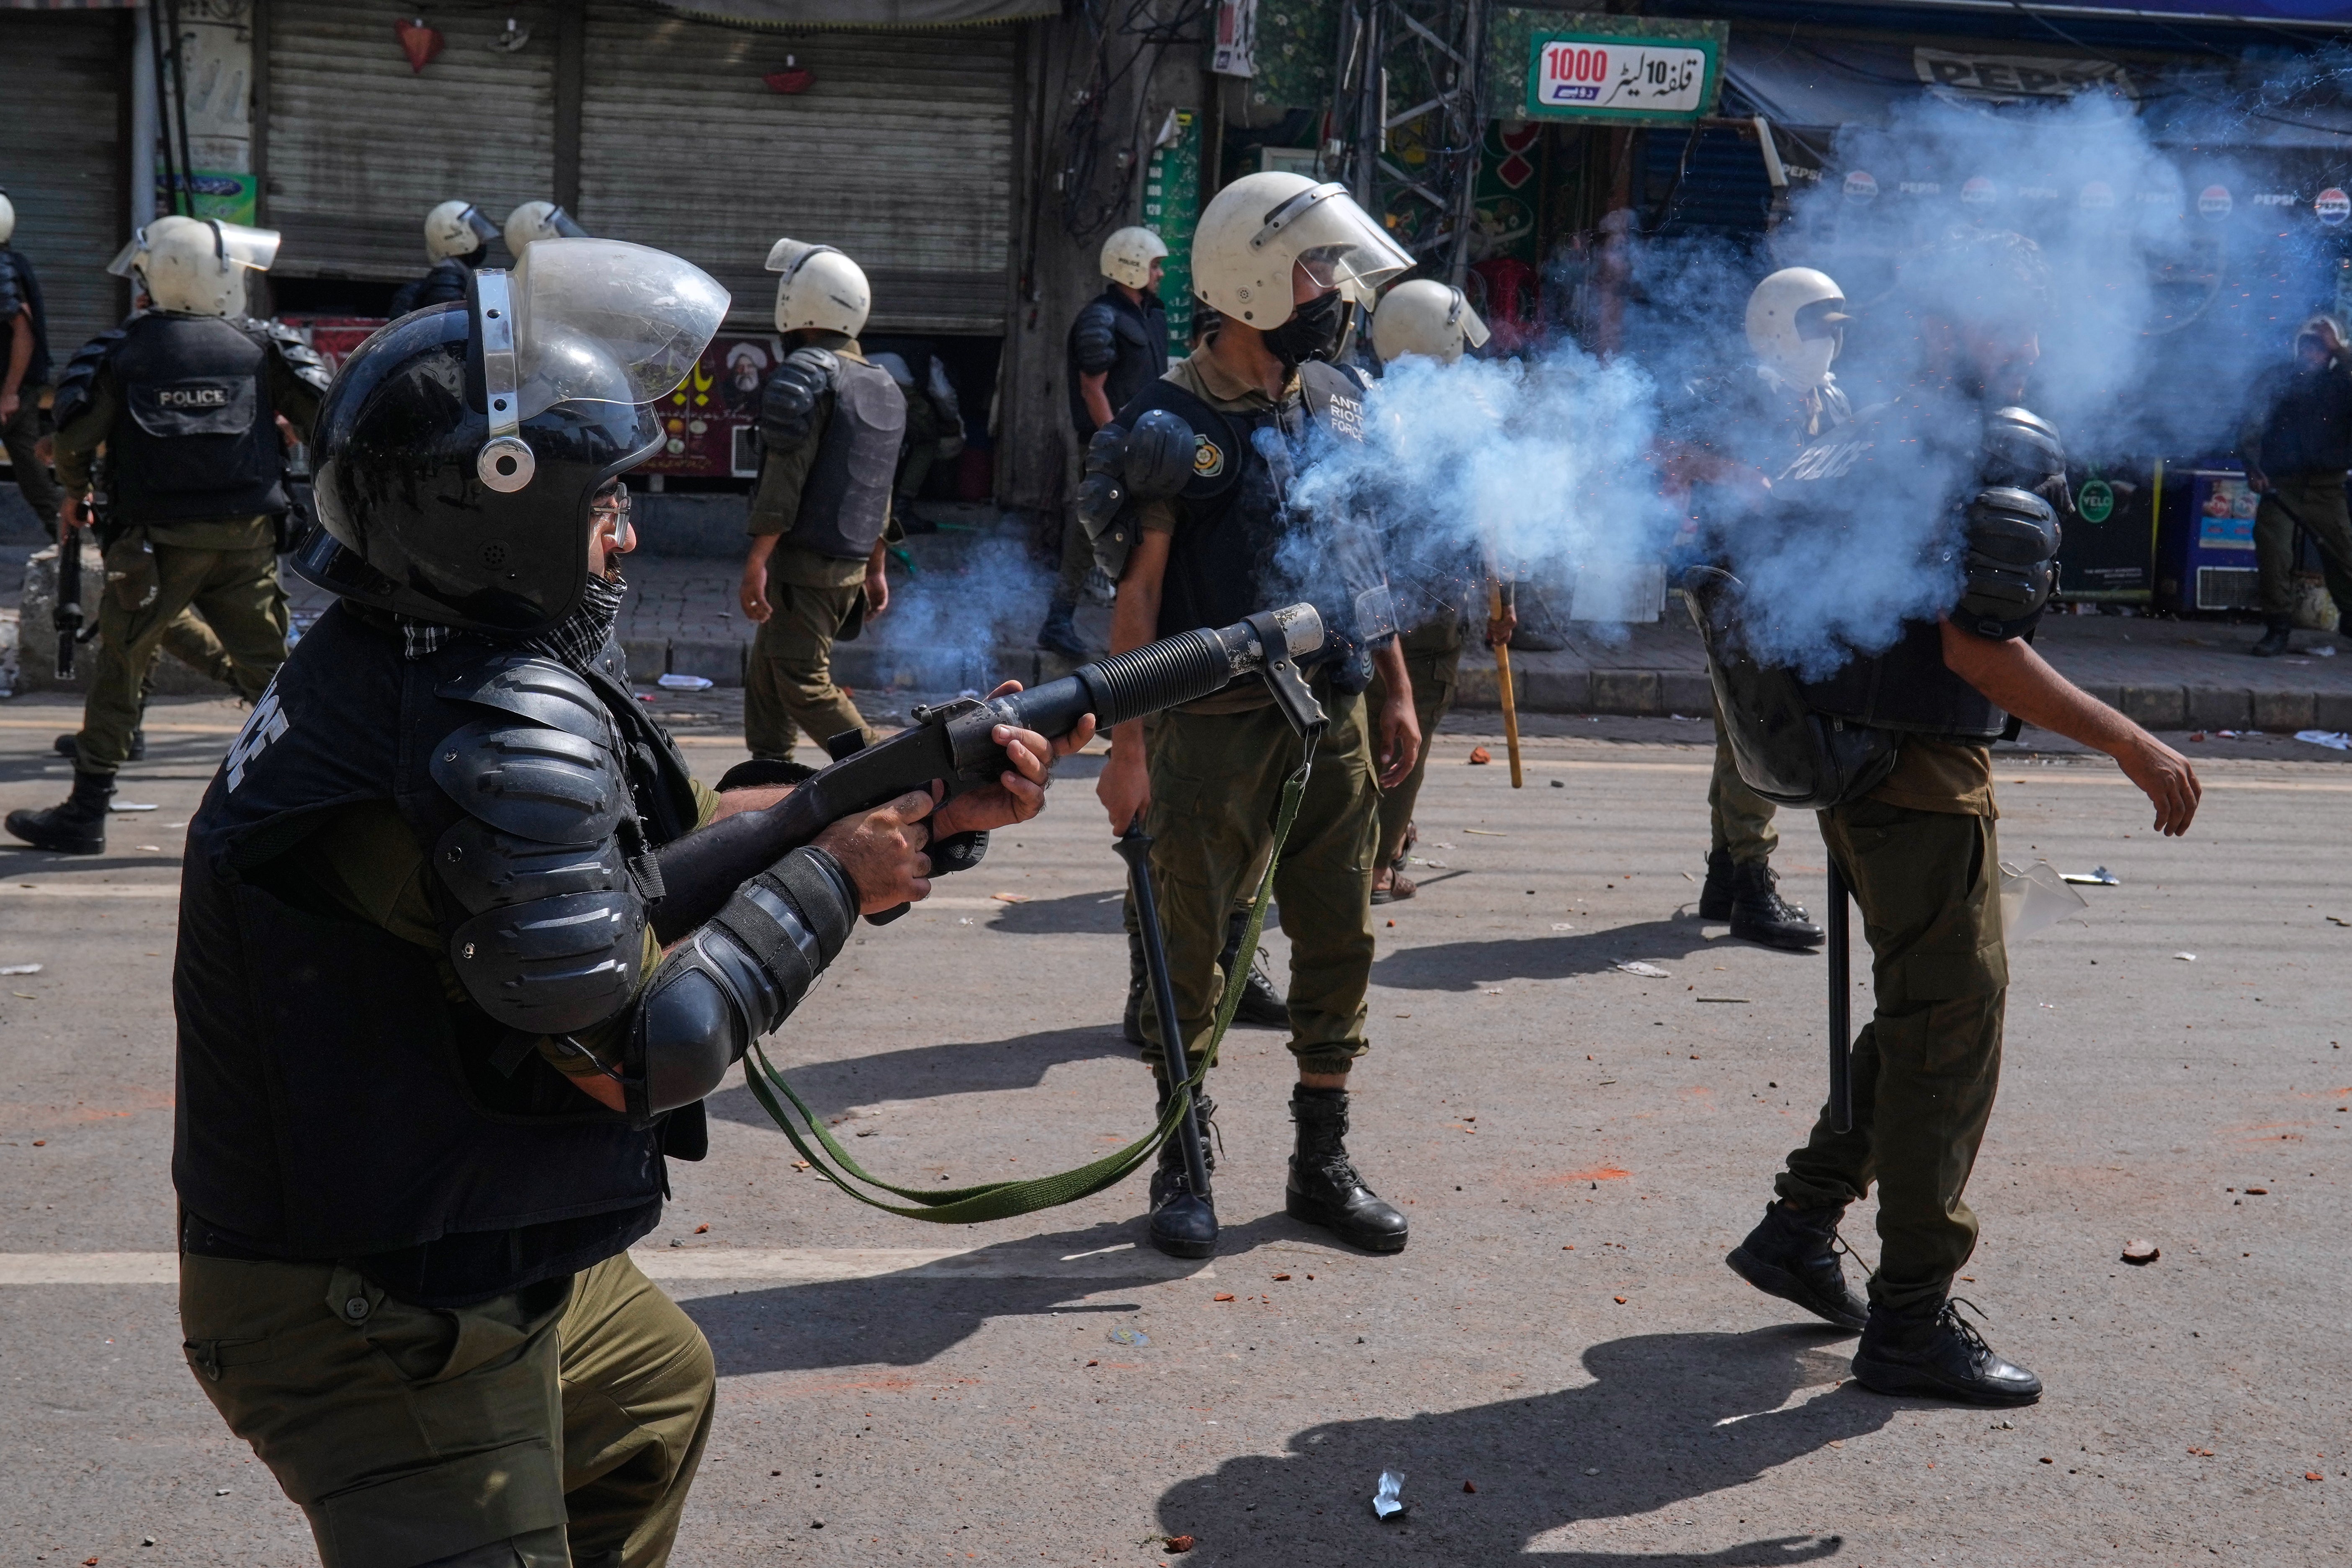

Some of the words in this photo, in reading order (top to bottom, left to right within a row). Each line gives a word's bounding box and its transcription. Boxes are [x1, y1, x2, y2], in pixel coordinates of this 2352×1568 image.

[1548, 48, 1608, 82] 1000
[1647, 60, 1667, 84] 10
[1929, 61, 2112, 95] PEP
[160, 390, 225, 405] POLICE
[1330, 394, 1363, 415] ANTI
[1330, 405, 1363, 427] RIOT
[1332, 418, 1364, 443] FORCE
[1777, 440, 1875, 480] POLICE
